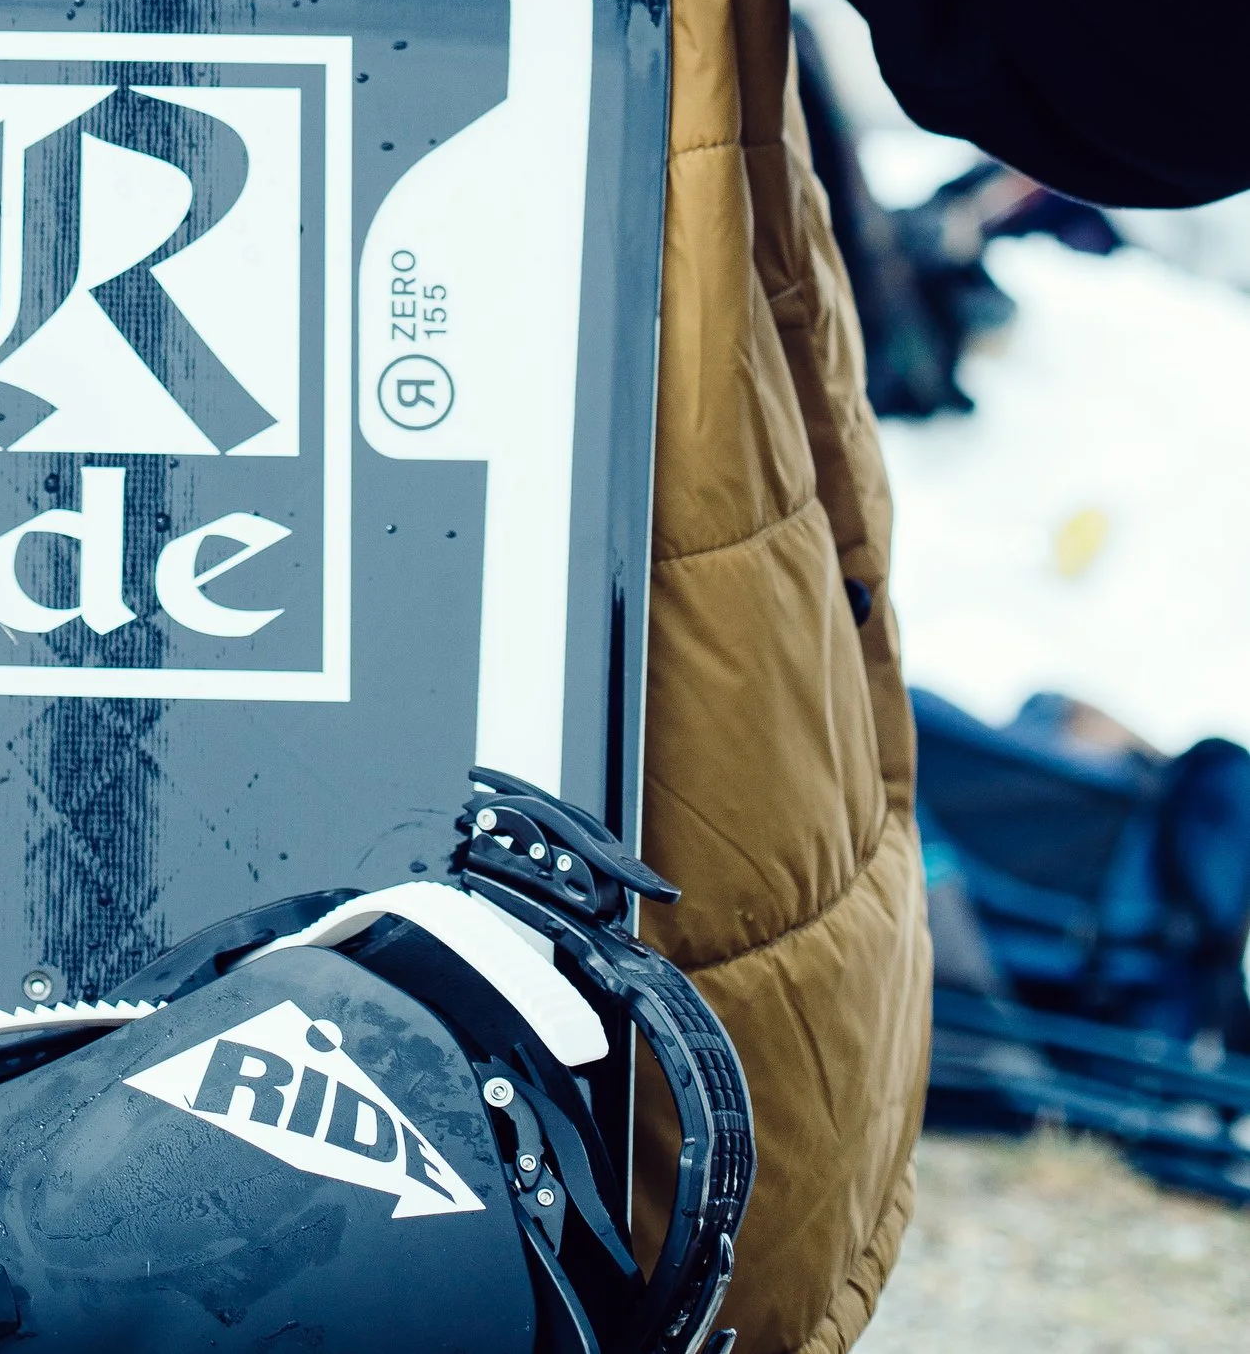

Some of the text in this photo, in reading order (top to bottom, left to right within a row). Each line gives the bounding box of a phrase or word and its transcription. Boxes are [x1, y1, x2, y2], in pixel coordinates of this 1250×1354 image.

[391, 249, 416, 342] ZERO
[423, 284, 447, 340] 155
[190, 1019, 457, 1204] RIDE
